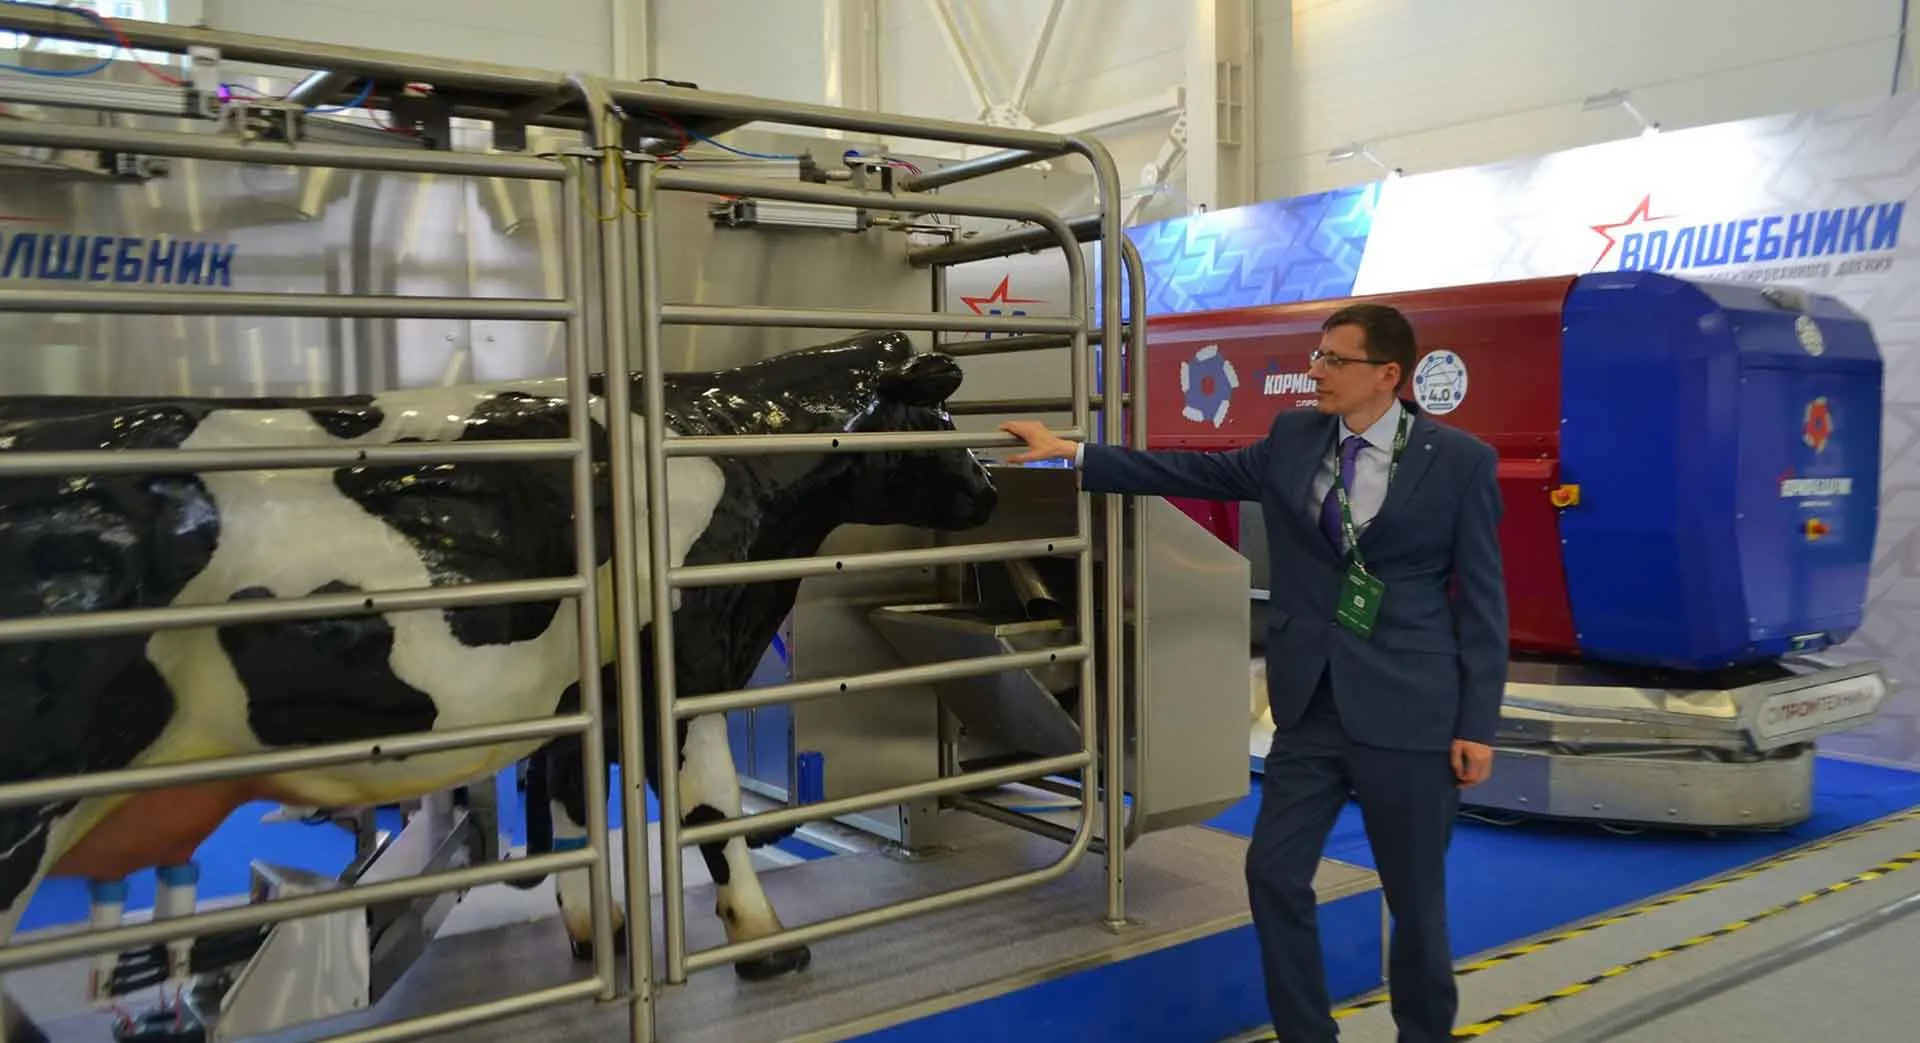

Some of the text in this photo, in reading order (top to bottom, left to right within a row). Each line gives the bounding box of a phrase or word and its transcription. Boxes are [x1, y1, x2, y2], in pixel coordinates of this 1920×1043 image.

[0, 233, 238, 287] ЛШЕБНИК
[1617, 200, 1905, 272] ВОЛШЕБНИКИ
[1429, 388, 1450, 402] 4.0
